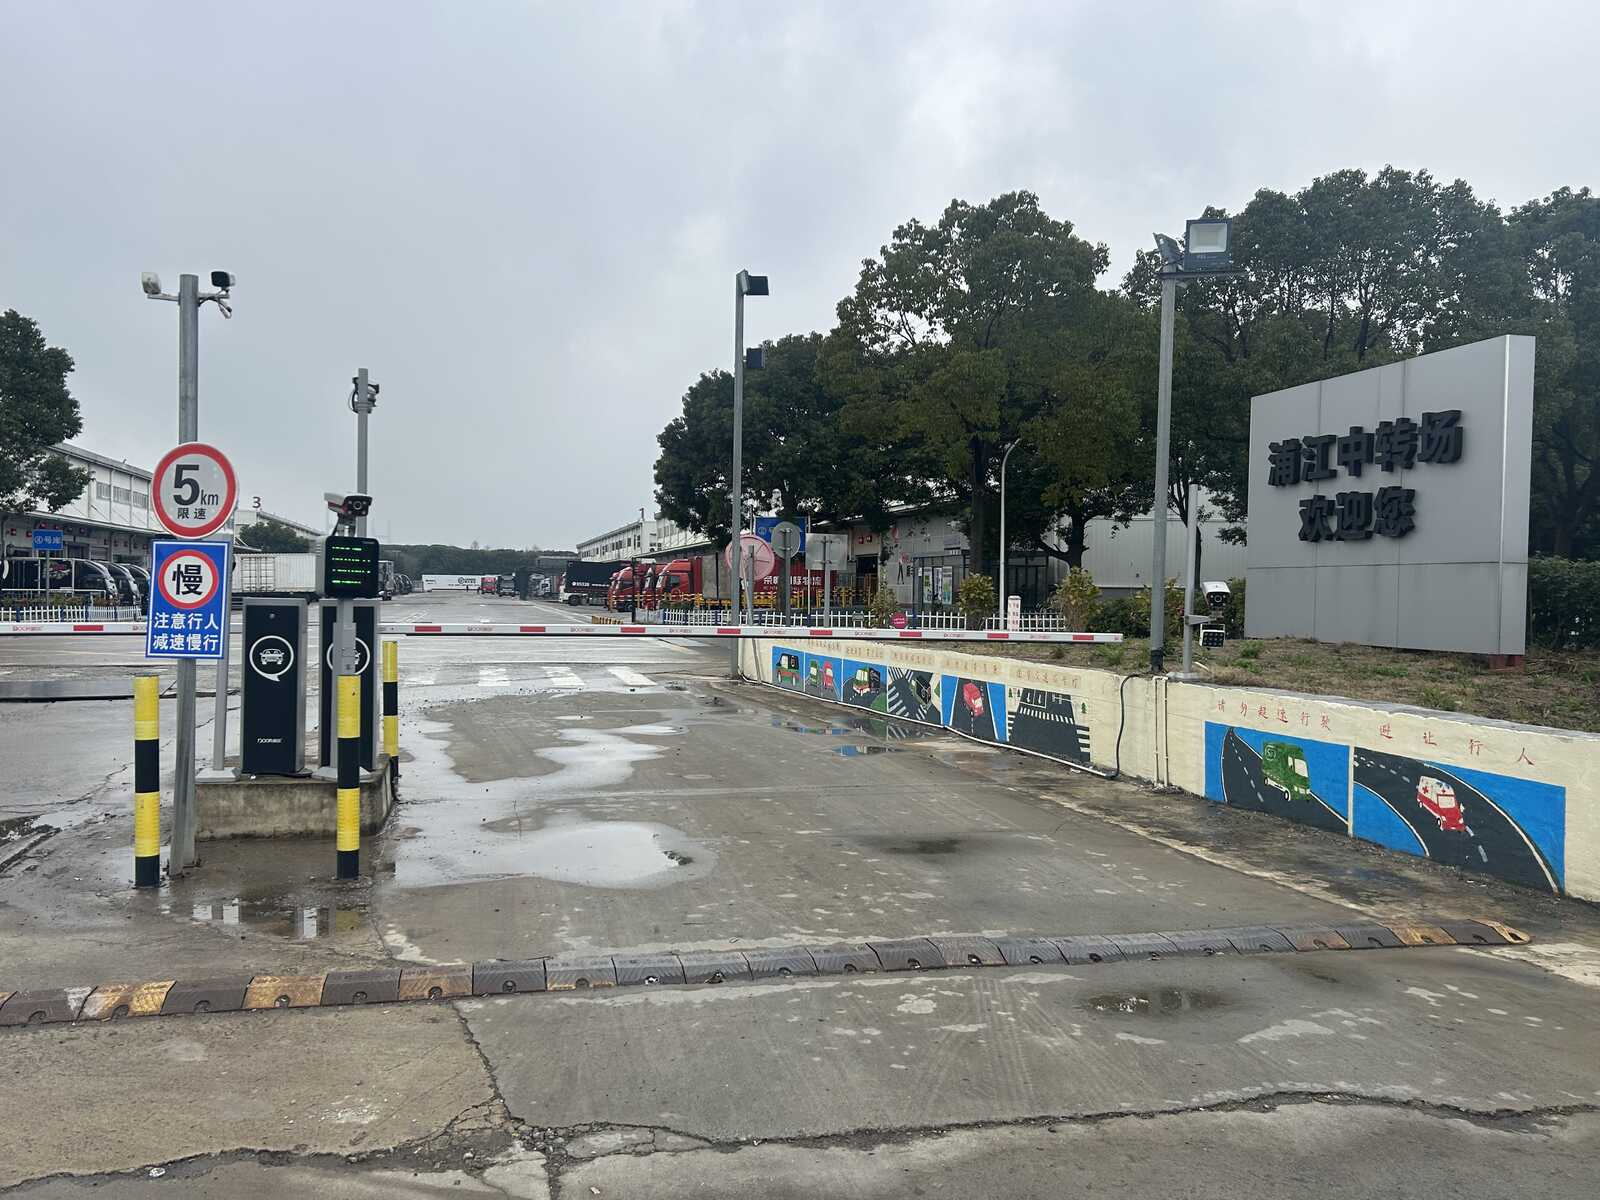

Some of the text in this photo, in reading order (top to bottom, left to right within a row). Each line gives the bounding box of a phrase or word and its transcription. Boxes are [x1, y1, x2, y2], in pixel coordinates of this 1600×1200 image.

[1268, 410, 1464, 486] 浦江中转场
[177, 507, 207, 519] 限速
[1298, 486, 1416, 542] 欢迎您
[172, 563, 203, 596] 慢
[154, 612, 219, 630] 注意行人
[152, 633, 219, 652] 减速慢行
[1379, 722, 1535, 766] 避让行人
